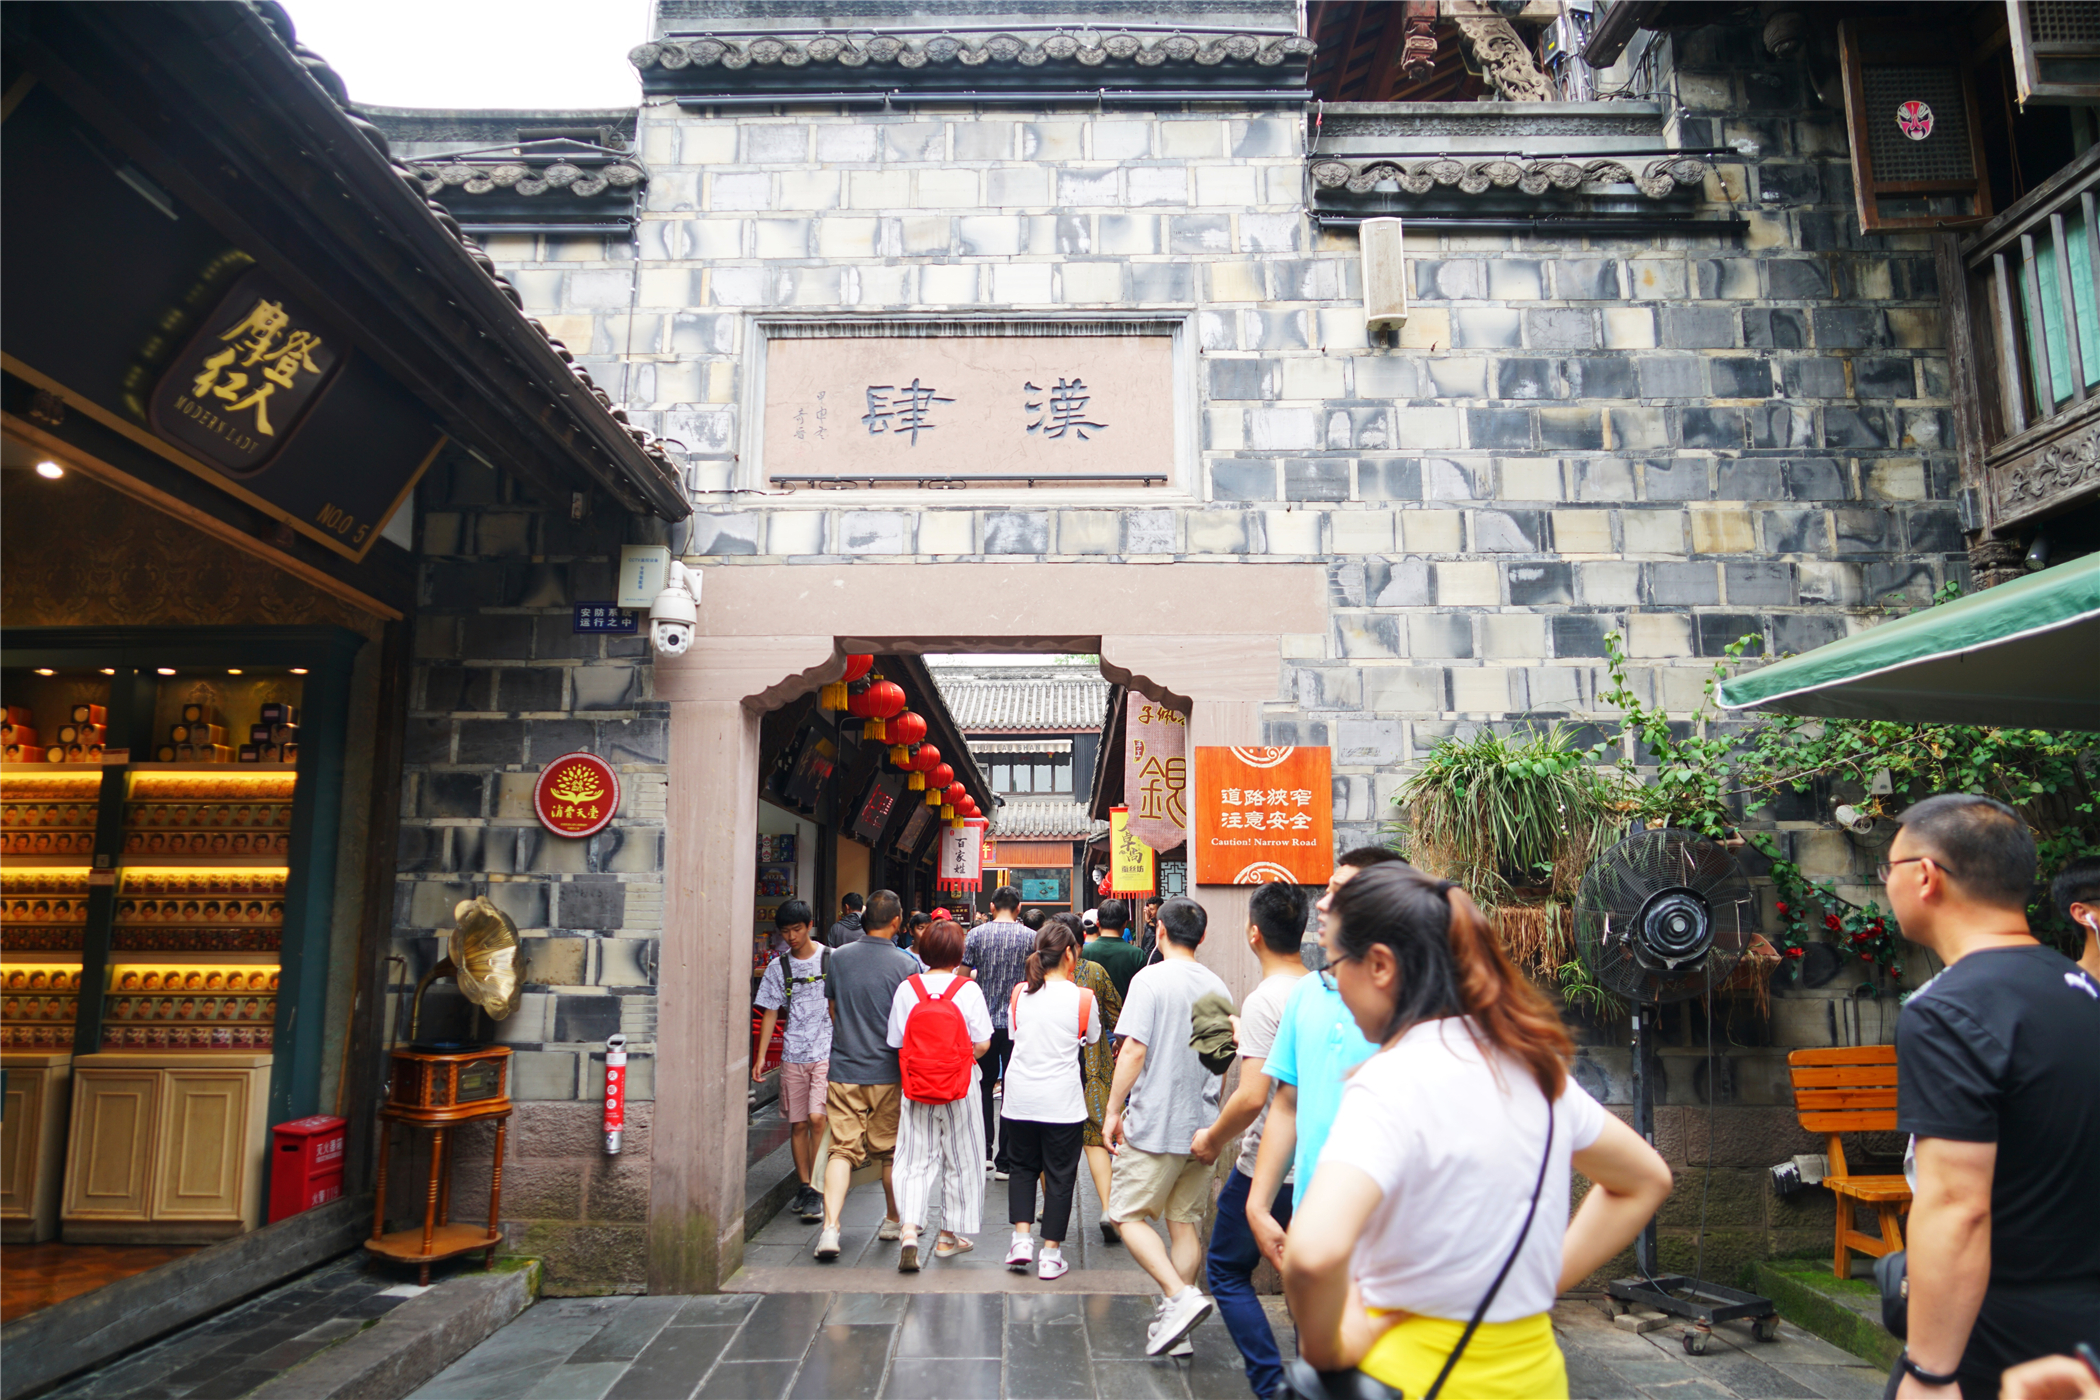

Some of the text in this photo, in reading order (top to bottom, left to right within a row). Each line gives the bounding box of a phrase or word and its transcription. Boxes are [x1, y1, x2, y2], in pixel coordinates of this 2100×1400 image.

[217, 298, 322, 389] 摩登
[174, 395, 259, 454] MODERN LADY
[580, 607, 632, 617] 安防系统
[579, 618, 632, 627] 运行之中
[1221, 810, 1313, 831] 注意安全
[1210, 837, 1317, 847] Caution! Narrow Road
[953, 837, 967, 874] 百家姓
[316, 1137, 343, 1157] 灭火器箱
